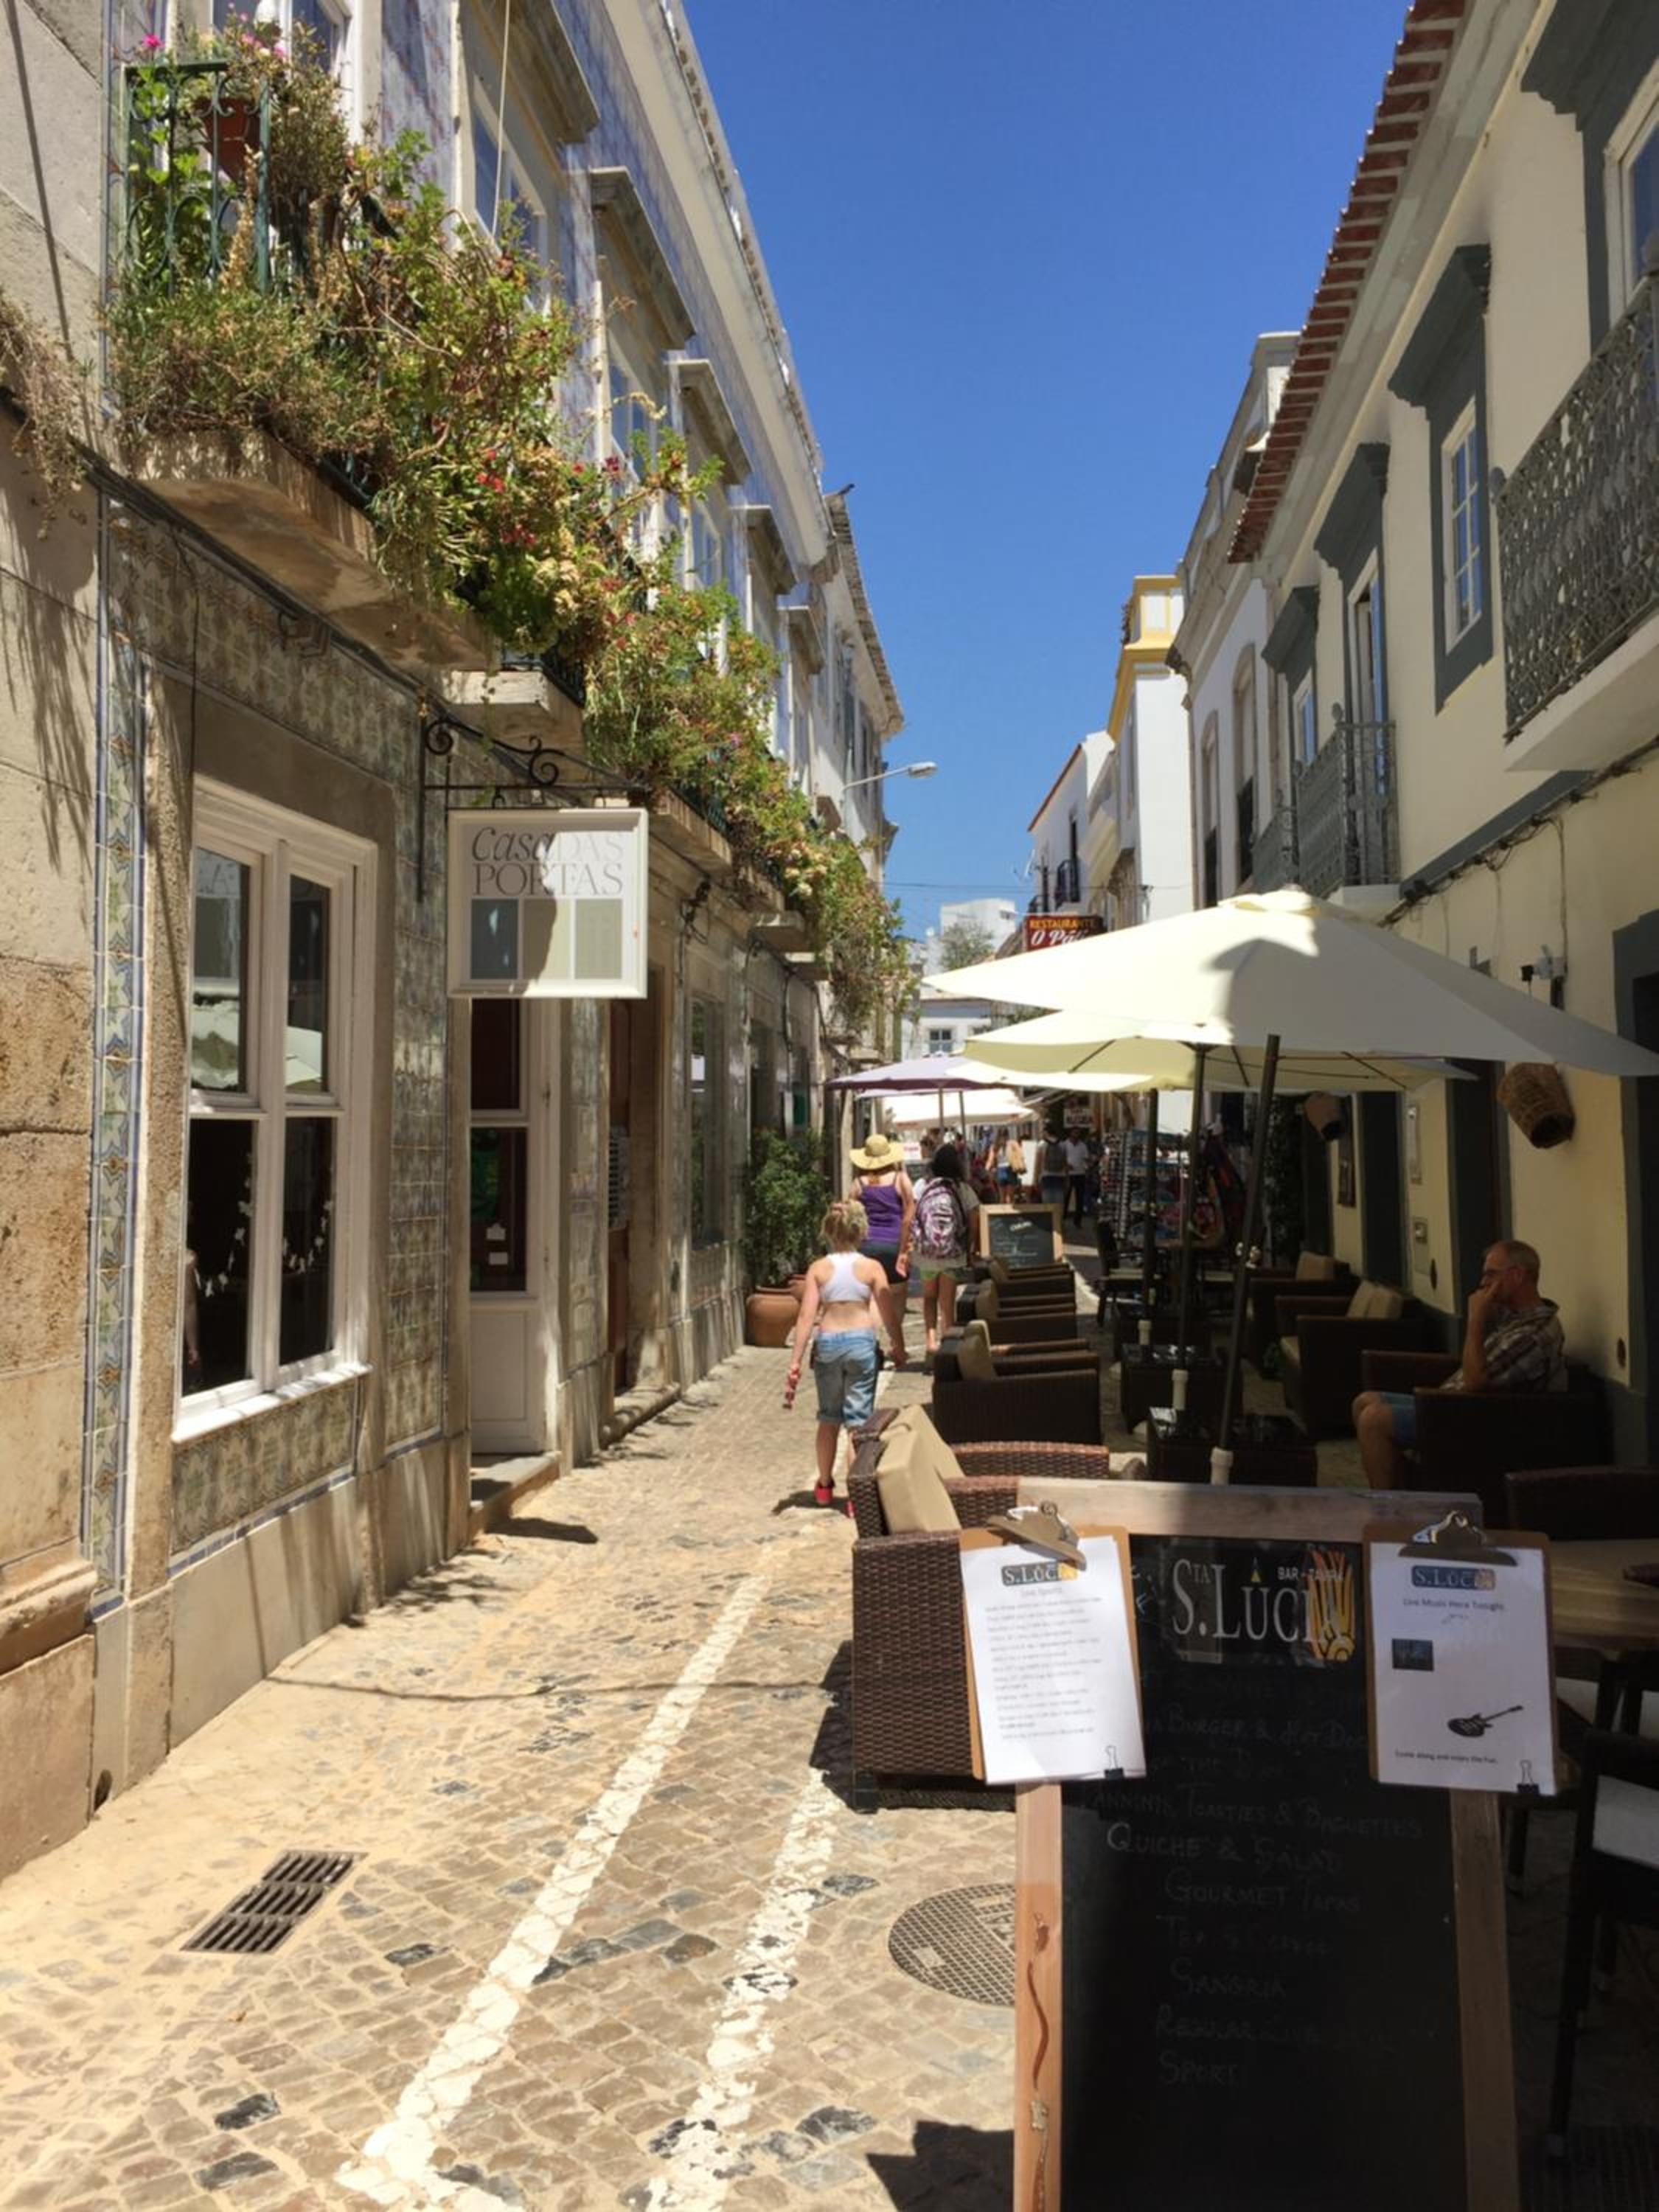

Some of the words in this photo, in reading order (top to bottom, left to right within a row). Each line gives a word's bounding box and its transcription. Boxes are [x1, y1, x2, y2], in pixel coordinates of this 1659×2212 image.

[472, 827, 553, 862] Casa
[473, 863, 623, 895] PORTAS
[1031, 929, 1046, 945] O
[1277, 1566, 1298, 1580] BAR
